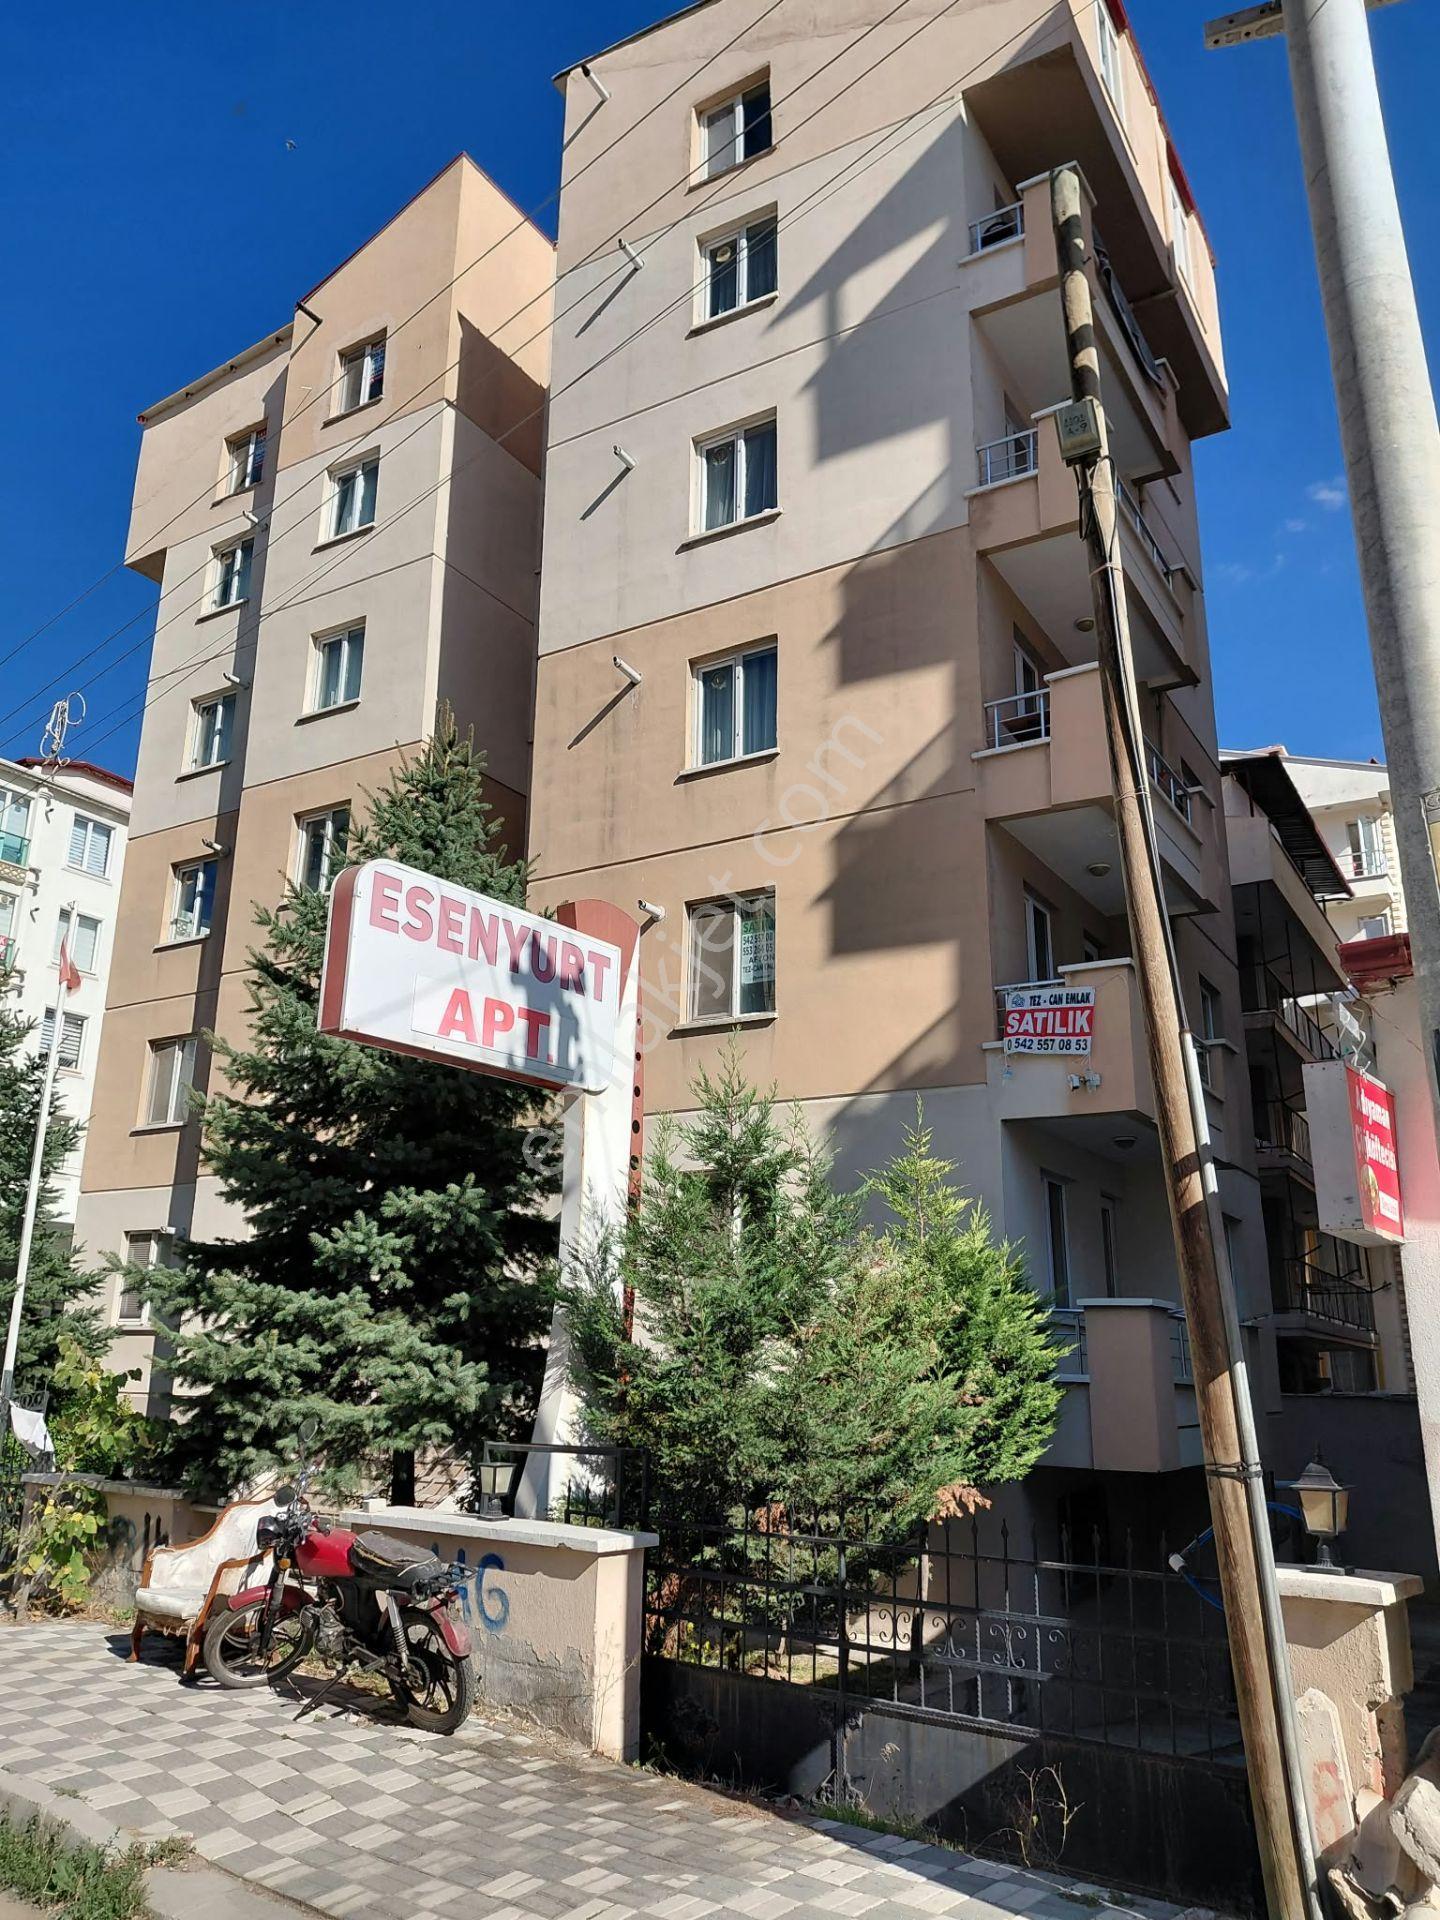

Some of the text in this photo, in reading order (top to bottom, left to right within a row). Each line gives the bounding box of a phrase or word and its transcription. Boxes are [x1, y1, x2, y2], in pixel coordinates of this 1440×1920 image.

[369, 870, 611, 1002] ESENYURT
[1029, 995, 1041, 1006] TEZ
[1049, 993, 1063, 1005] CAN
[1065, 992, 1091, 1004] EMLAK
[437, 987, 554, 1063] APT.
[1007, 1009, 1091, 1034] SATILIK
[1007, 1038, 1088, 1051] 0 542 557 08 53
